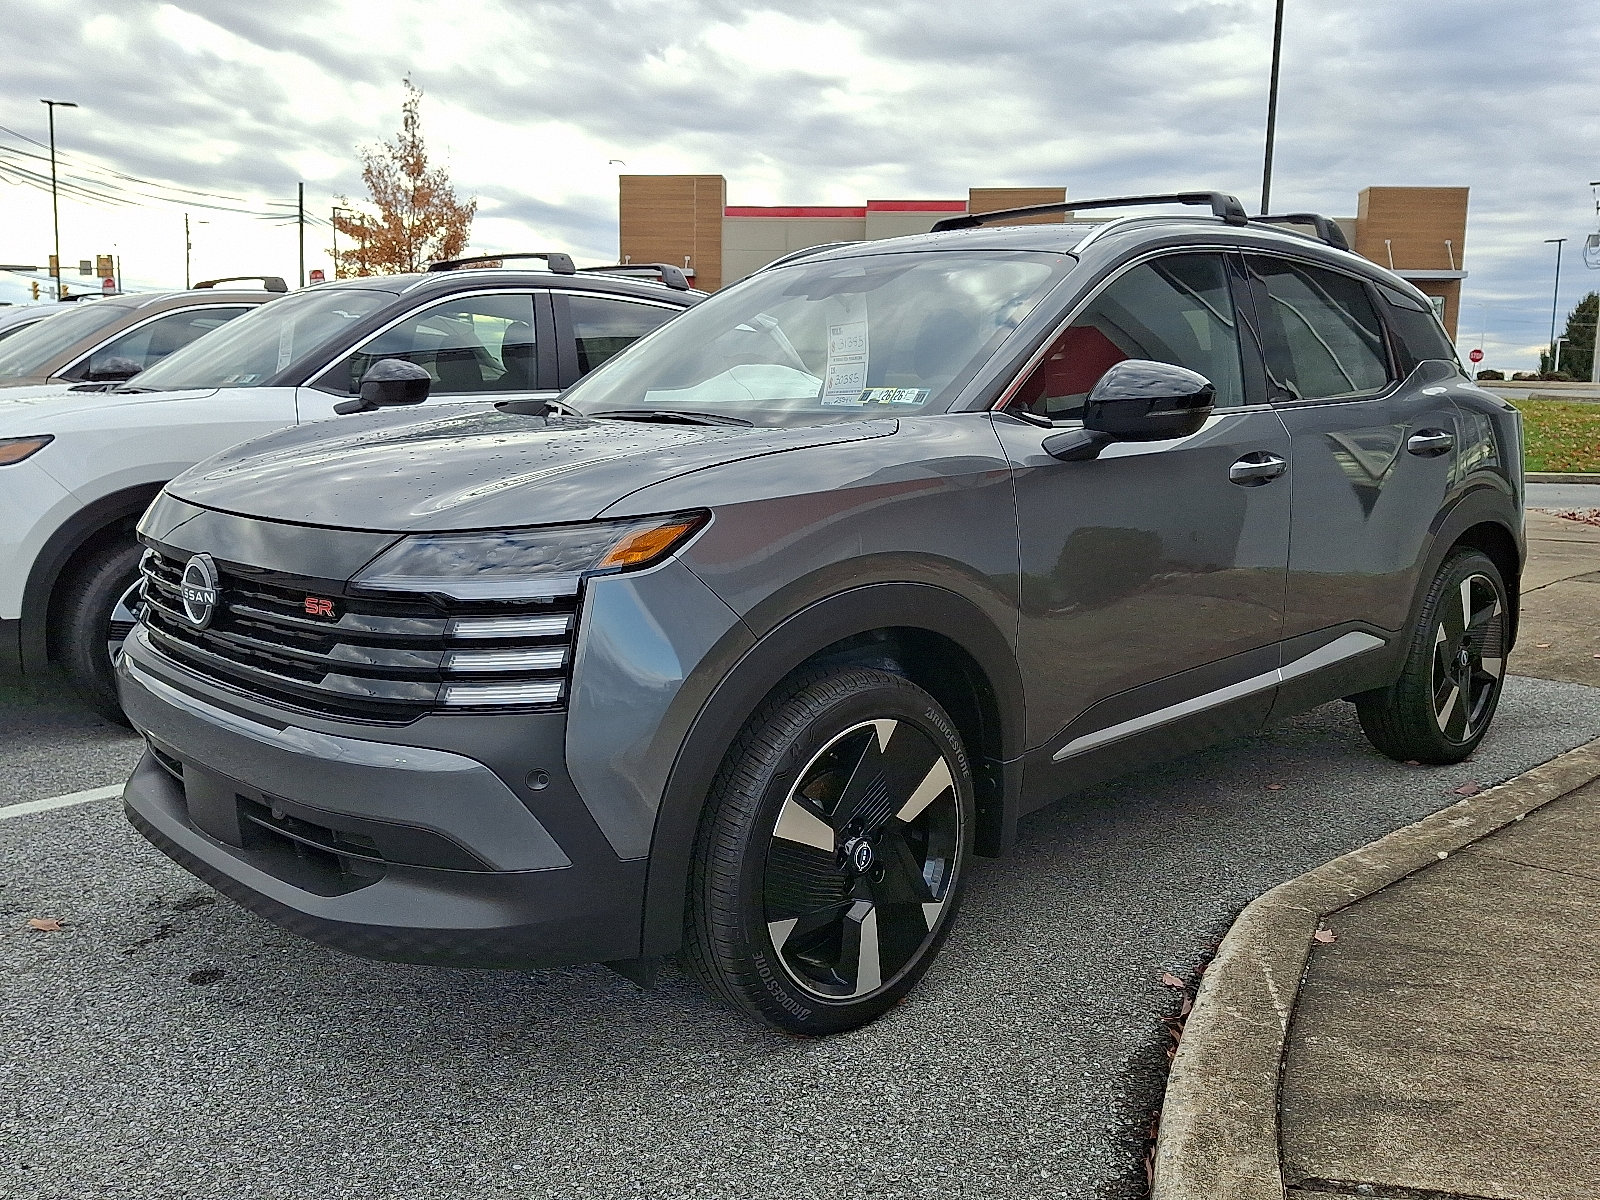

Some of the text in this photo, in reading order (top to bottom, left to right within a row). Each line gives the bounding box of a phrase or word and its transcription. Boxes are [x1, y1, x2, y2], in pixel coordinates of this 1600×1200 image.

[893, 390, 906, 401] 26
[184, 588, 213, 603] SSAN
[304, 597, 335, 617] SR
[924, 707, 969, 778] BRIDGESTONE
[752, 950, 812, 1021] BRIDGESTONE
